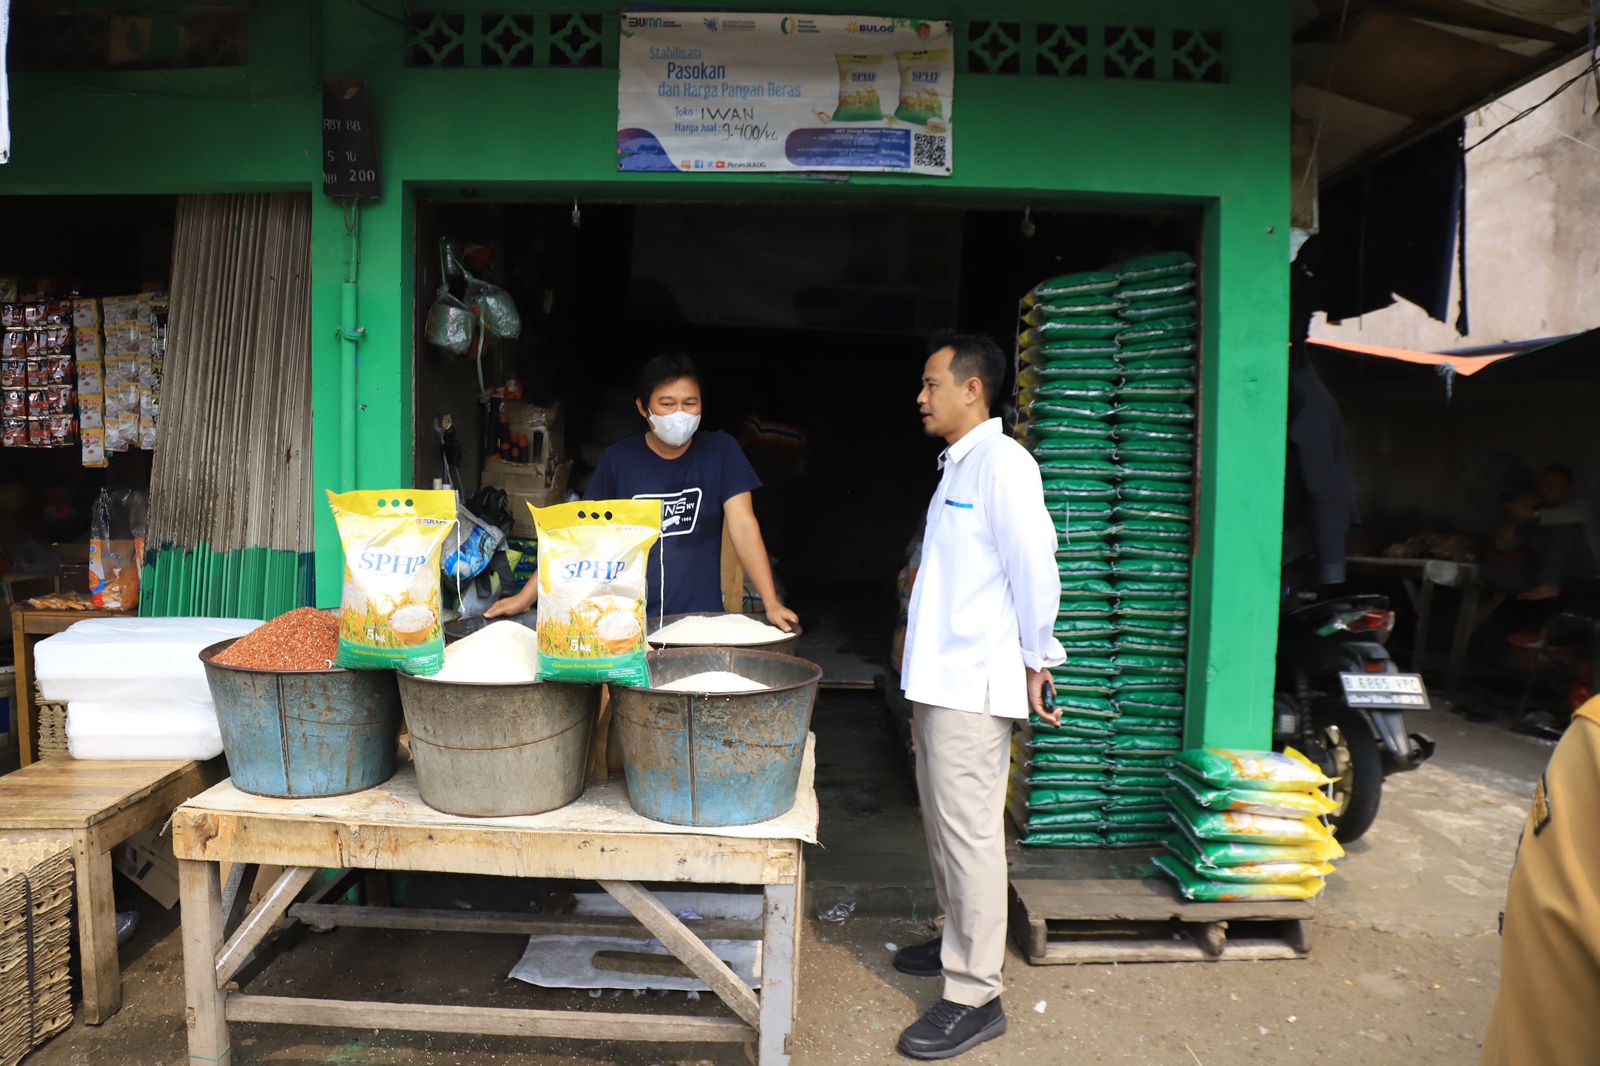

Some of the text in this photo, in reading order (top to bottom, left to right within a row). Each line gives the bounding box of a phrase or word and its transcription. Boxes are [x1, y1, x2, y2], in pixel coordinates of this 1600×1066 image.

[859, 24, 895, 33] BULOG
[649, 46, 702, 60] Stabilisasi
[667, 61, 726, 80] Pasokan
[658, 82, 801, 99] dan Harga Pangan Beras
[701, 107, 754, 121] IWAN
[674, 123, 699, 134] Harga
[700, 123, 717, 133] Jual
[348, 170, 376, 182] 200
[358, 551, 427, 575] SPHP
[561, 559, 626, 582] SPHP
[1344, 677, 1353, 689] B
